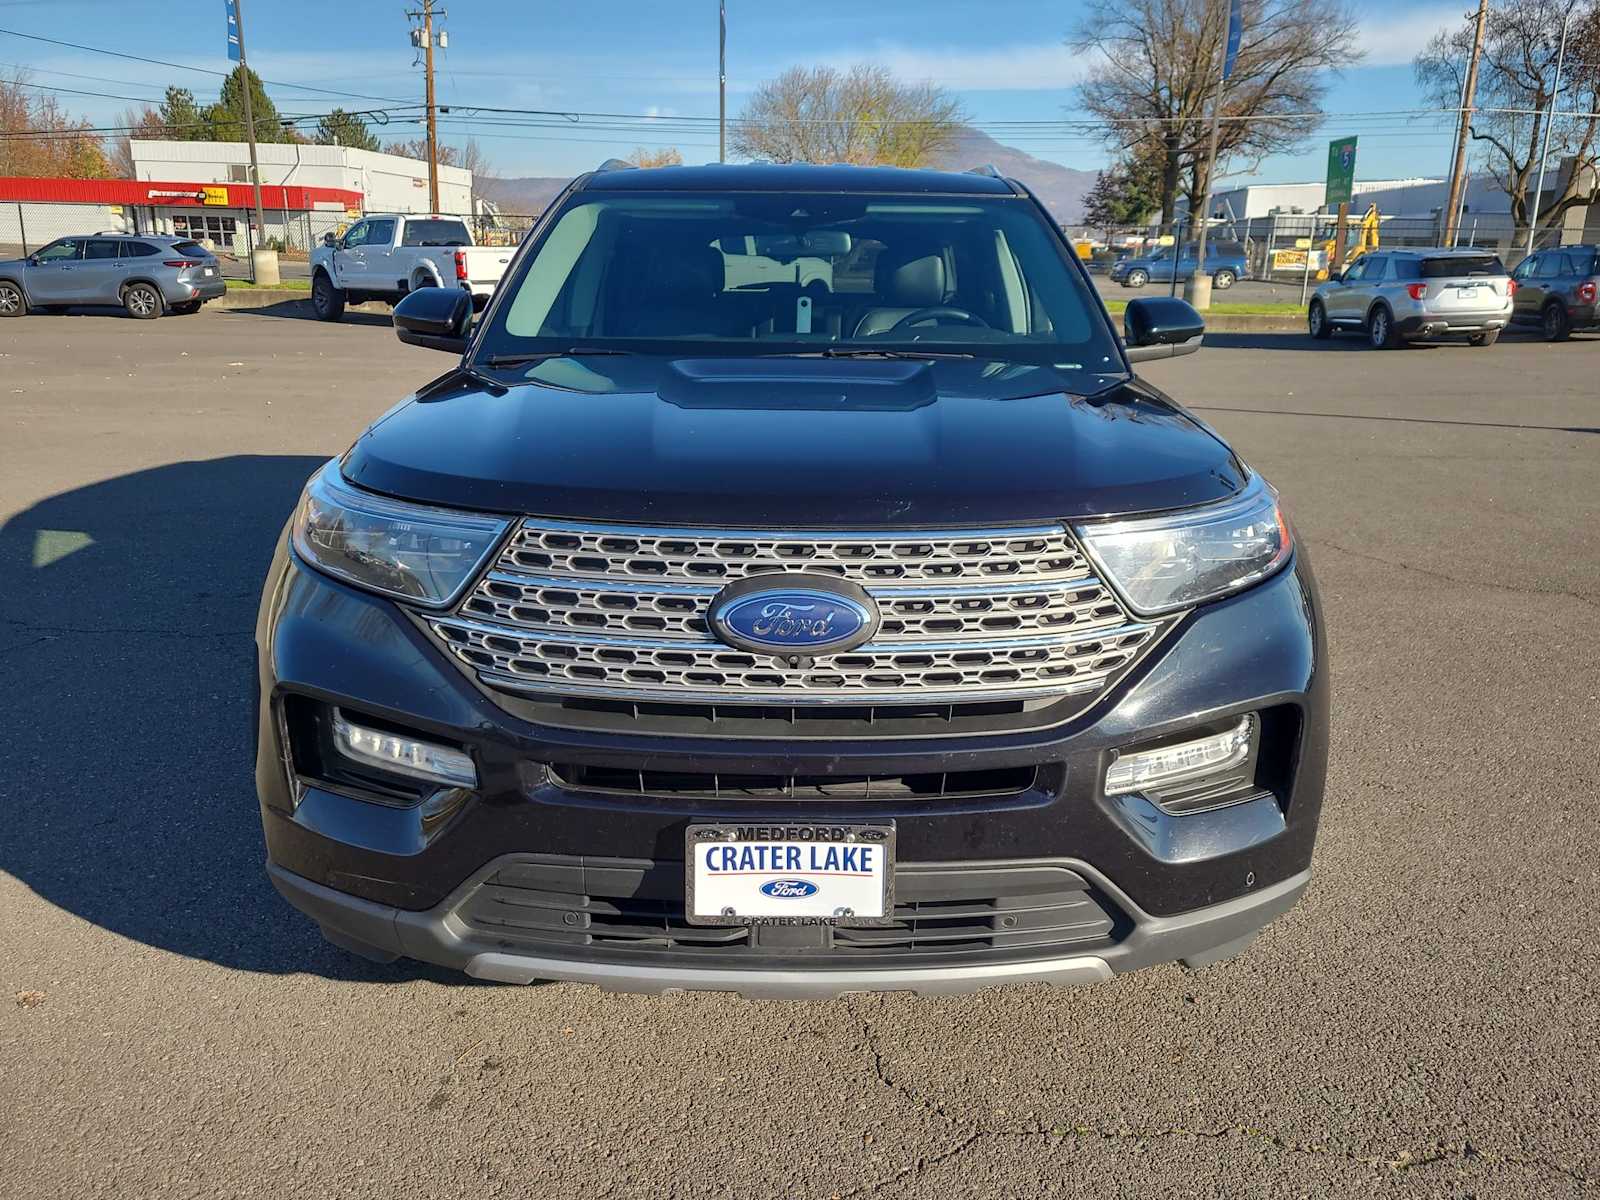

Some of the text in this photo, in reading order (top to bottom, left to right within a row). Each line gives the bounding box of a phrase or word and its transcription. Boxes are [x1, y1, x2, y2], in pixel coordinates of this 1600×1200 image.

[752, 602, 835, 637] Ford
[736, 827, 845, 842] MEDFORD
[705, 846, 873, 873] CRATER LAKE
[770, 881, 807, 897] Ford
[742, 917, 838, 926] CRATER LAKE
